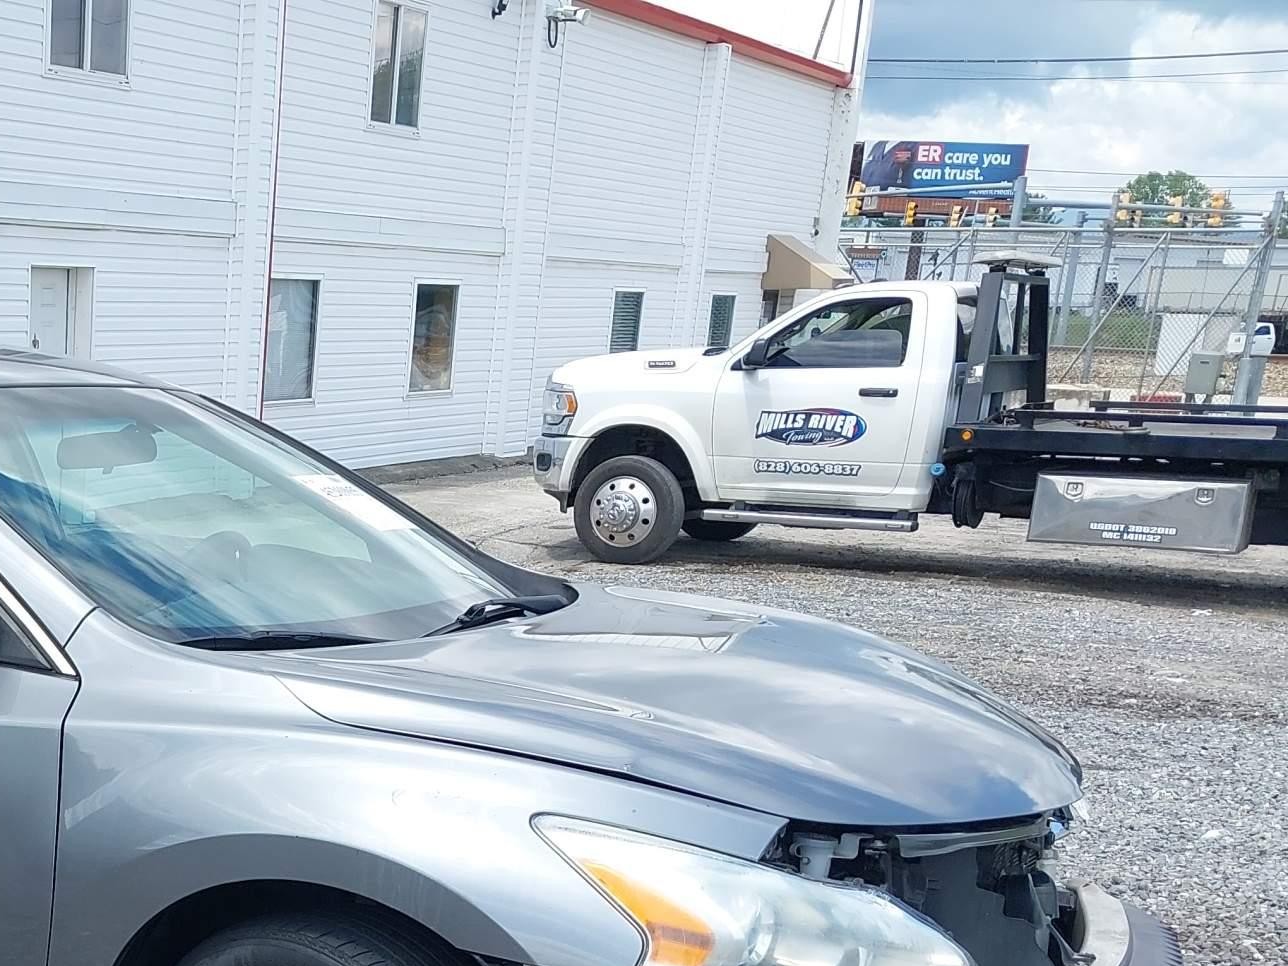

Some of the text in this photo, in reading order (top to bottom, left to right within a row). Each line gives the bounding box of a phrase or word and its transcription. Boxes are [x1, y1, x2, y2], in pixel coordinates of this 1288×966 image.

[917, 145, 942, 162] ER
[944, 152, 979, 164] care
[982, 153, 1011, 167] you
[913, 166, 984, 181] can trust.
[757, 412, 858, 438] MILLS RIVER
[782, 429, 823, 446] Towing
[1089, 522, 1126, 532] USDOT
[1101, 531, 1121, 540] MC
